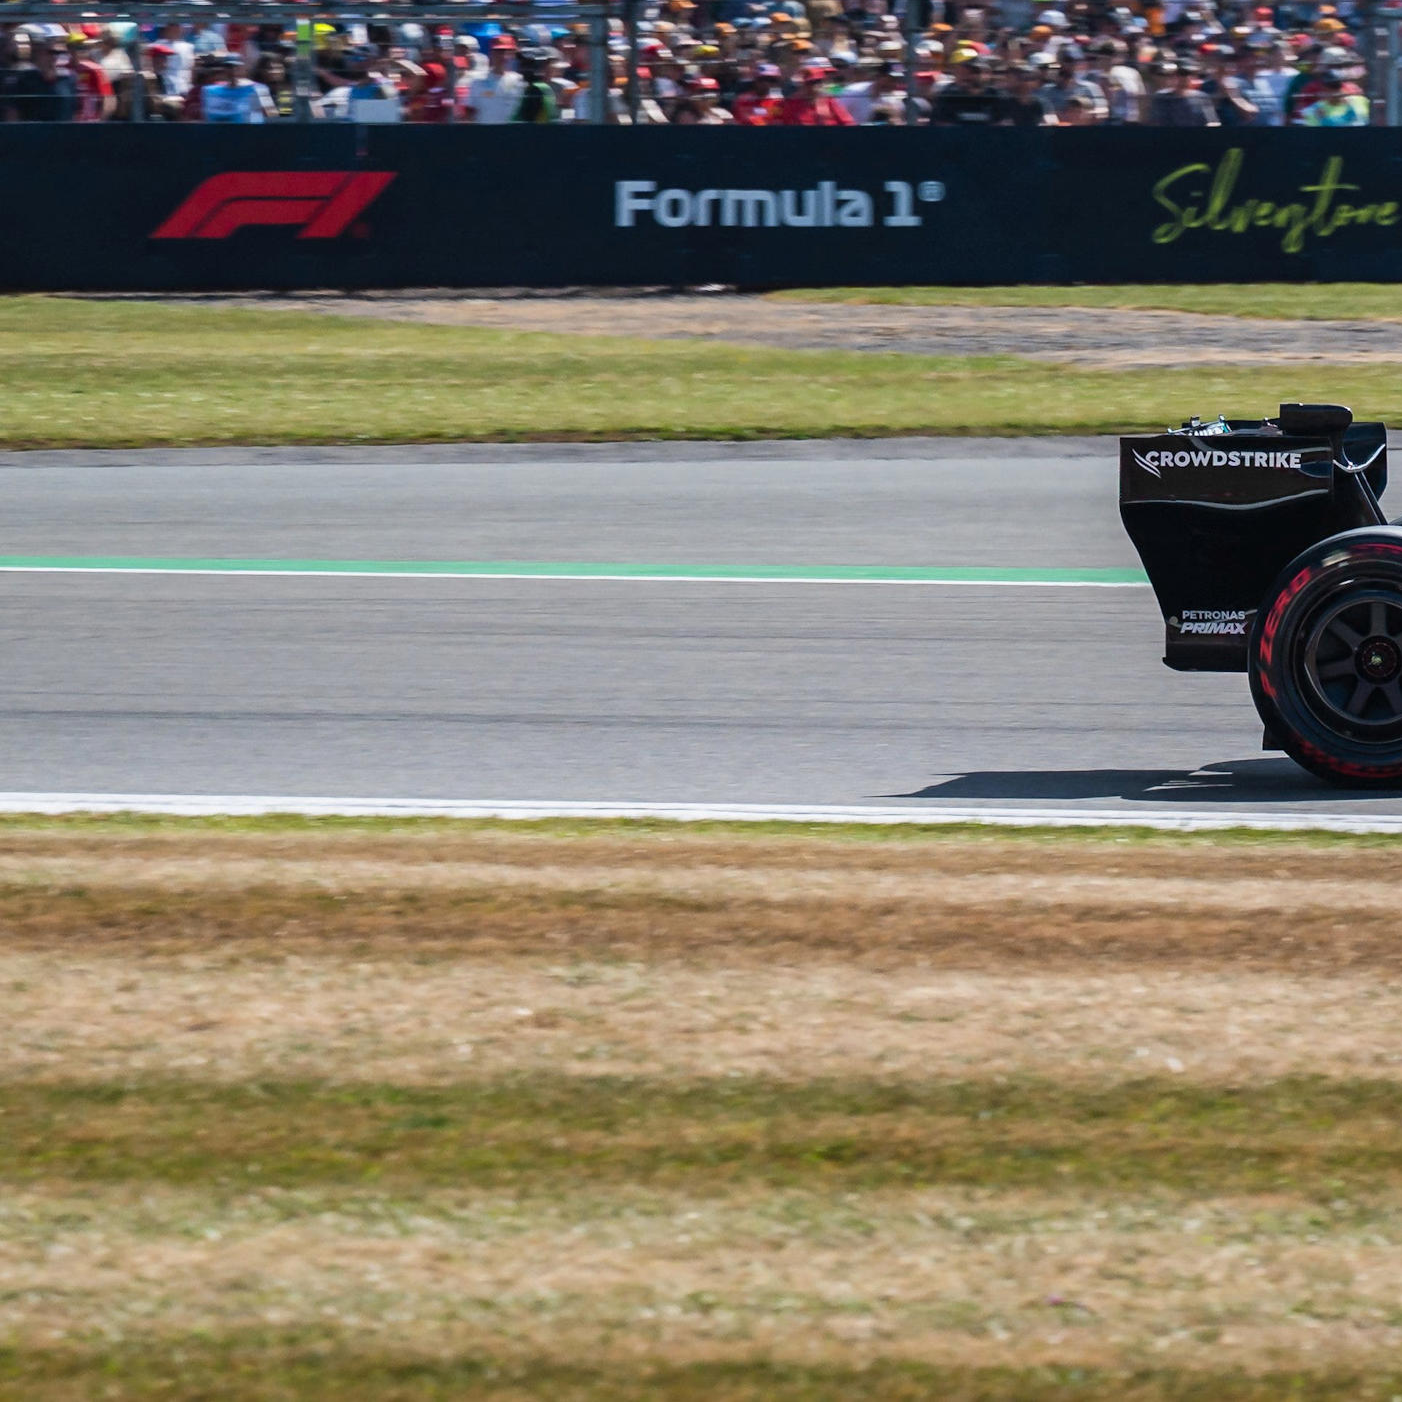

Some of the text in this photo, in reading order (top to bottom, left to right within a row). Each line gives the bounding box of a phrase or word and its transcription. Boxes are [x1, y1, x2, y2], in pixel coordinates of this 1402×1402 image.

[615, 180, 873, 227] Formula
[1152, 148, 1400, 253] Silverstone
[1145, 450, 1302, 469] CROWDSTRIKE
[1182, 610, 1246, 621] PETRONAS
[1179, 622, 1247, 635] PRIMAX
